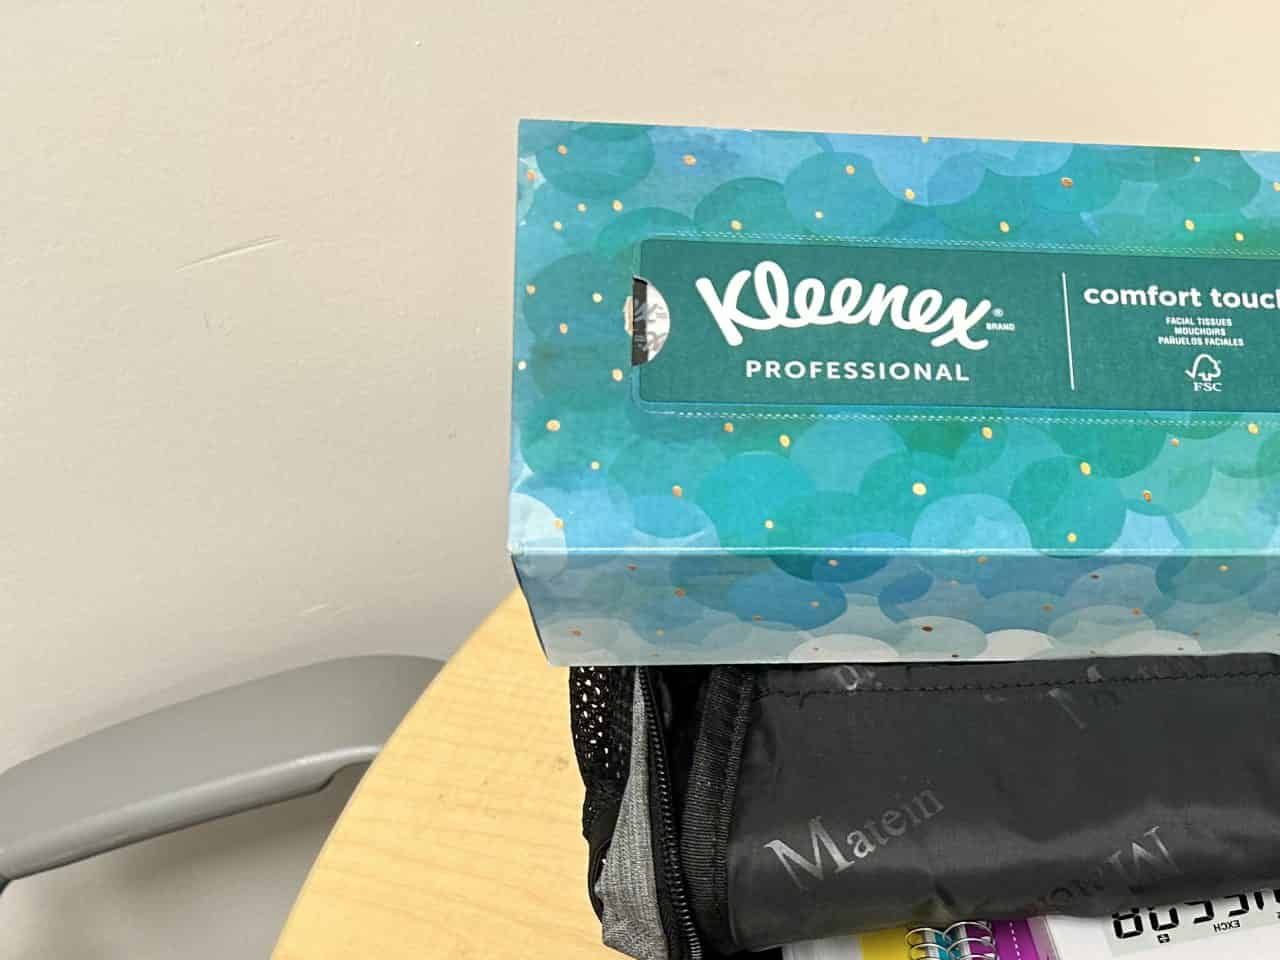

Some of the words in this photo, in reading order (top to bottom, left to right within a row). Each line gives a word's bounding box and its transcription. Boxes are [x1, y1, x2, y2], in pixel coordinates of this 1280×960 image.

[1083, 285, 1202, 307] comfort
[695, 260, 991, 351] Kleenex
[1165, 316, 1195, 326] FACIAL
[1198, 317, 1233, 327] TISSUES
[1174, 327, 1227, 337] MOUCHOIRS
[1204, 337, 1245, 347] FACIALES
[746, 359, 970, 382] PROFESSIONAL
[1193, 382, 1224, 392] FSC
[1212, 919, 1241, 933] EXCH
